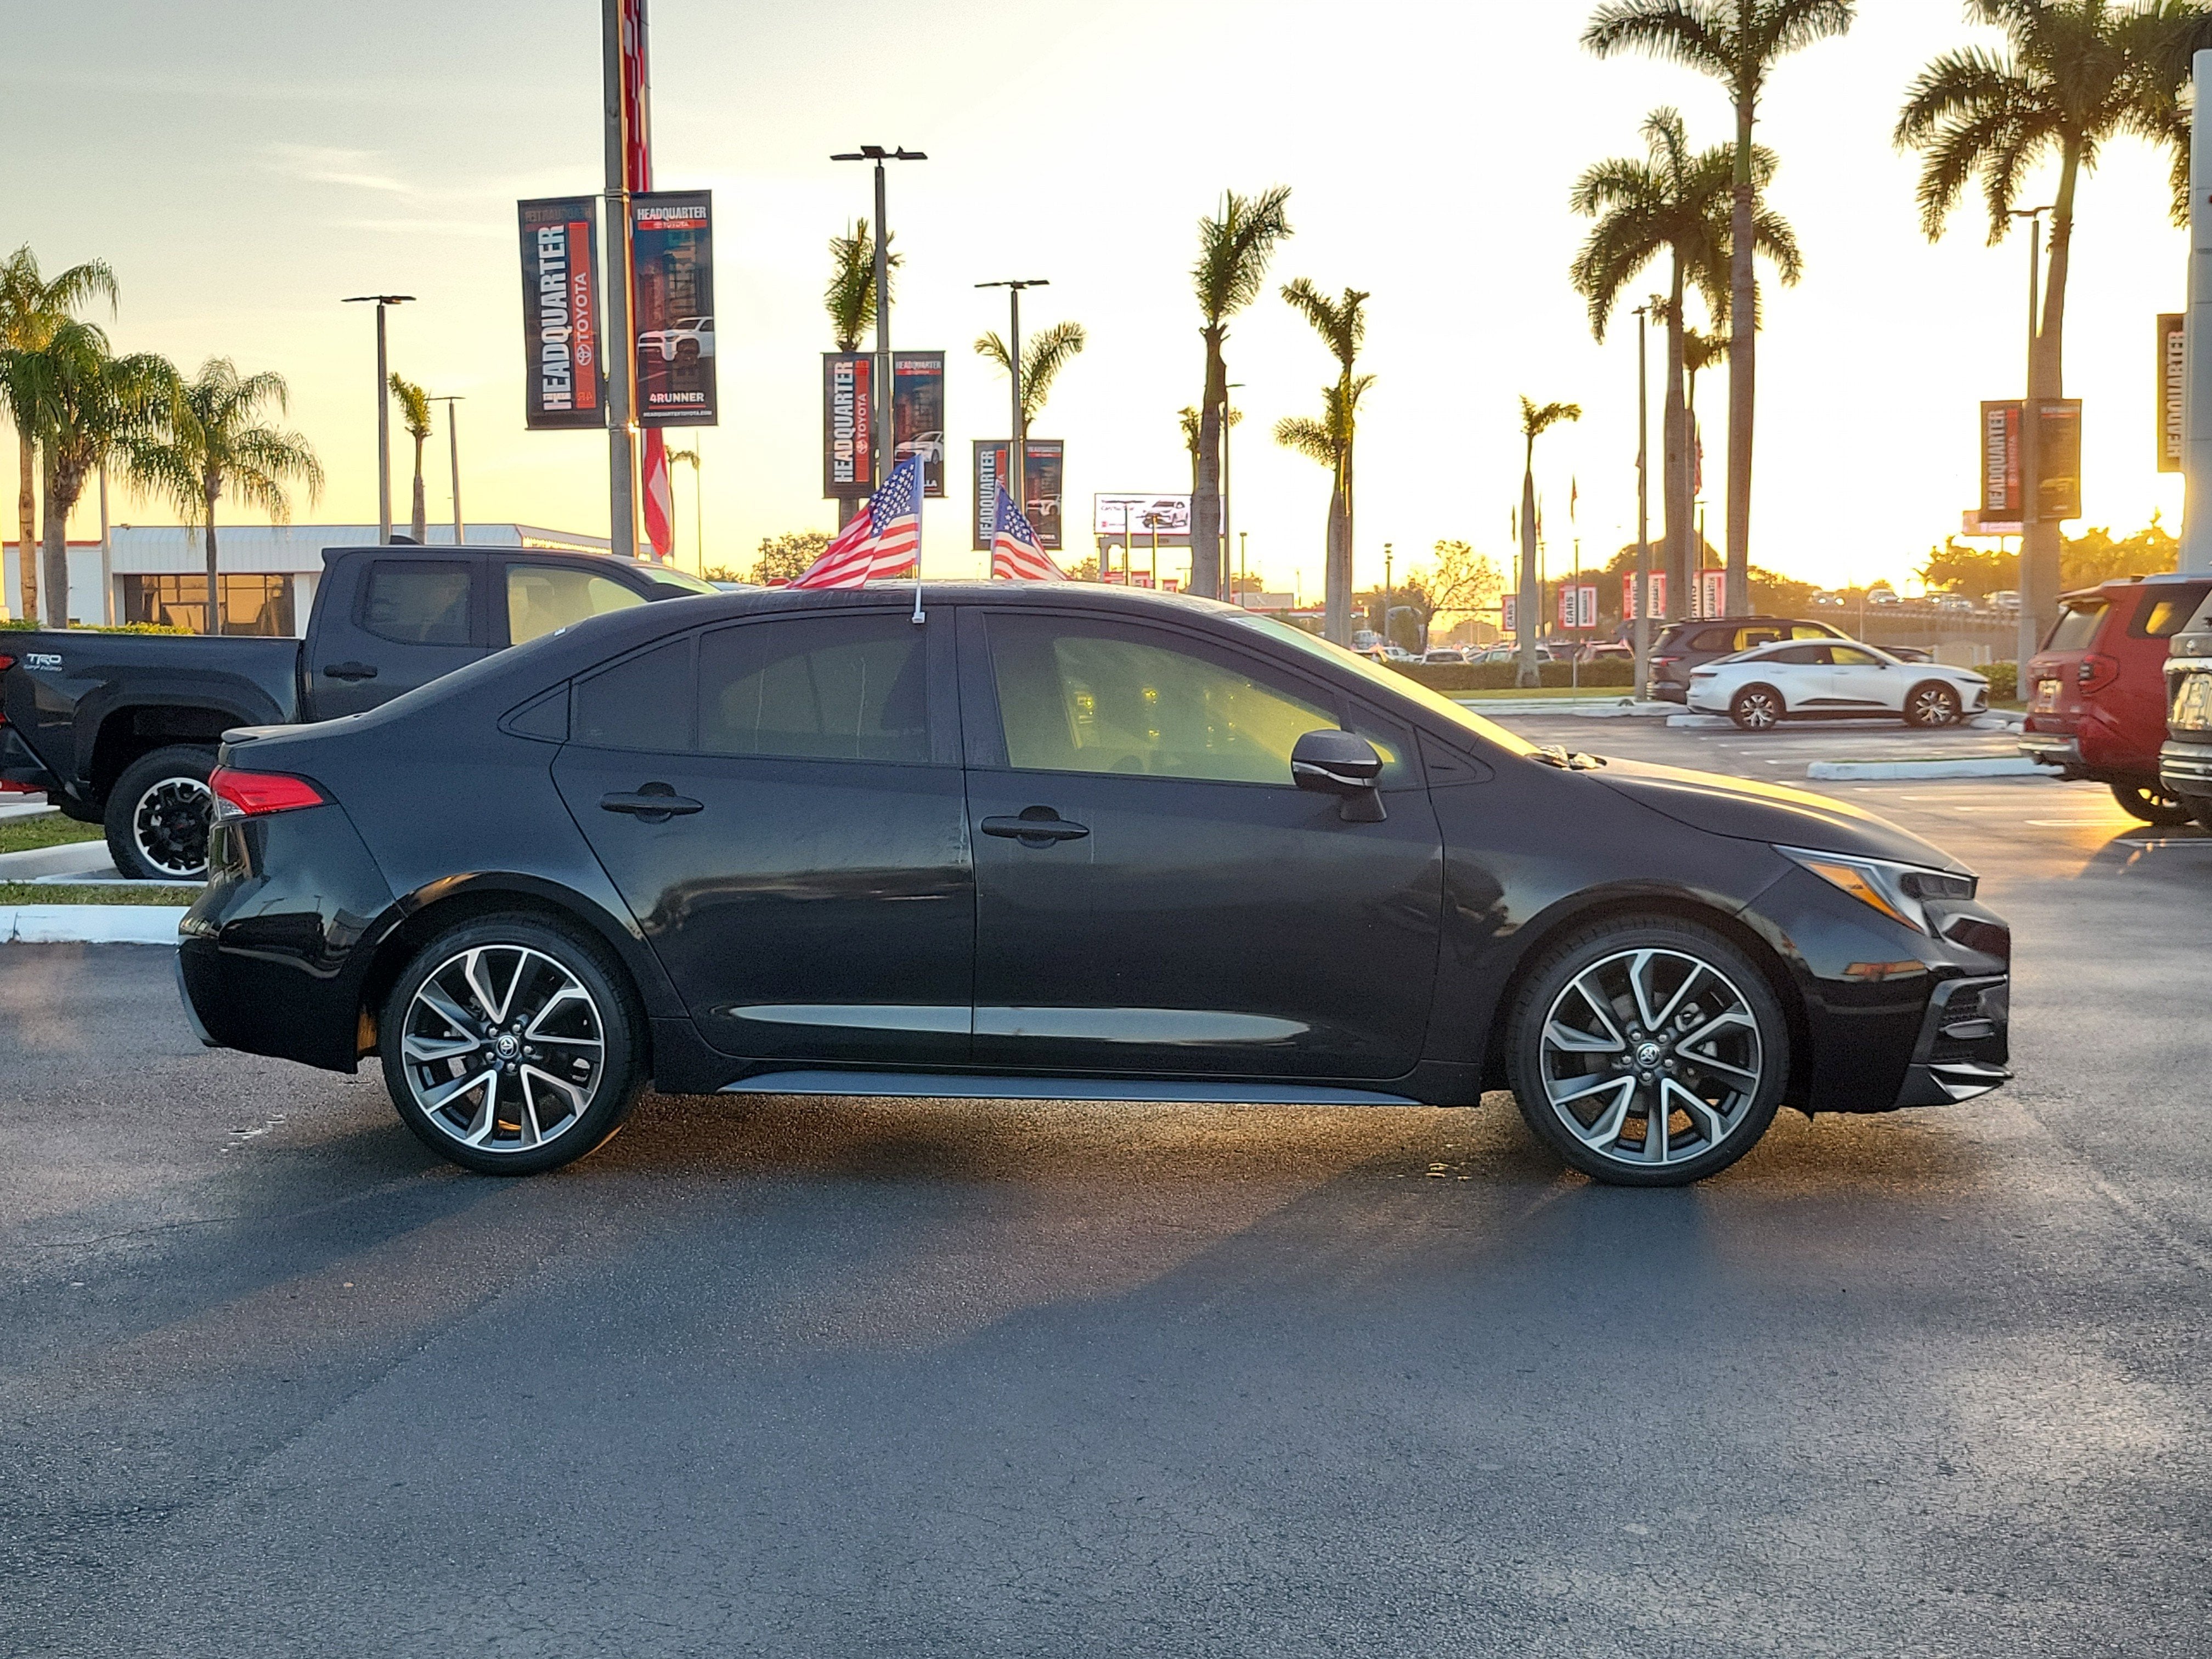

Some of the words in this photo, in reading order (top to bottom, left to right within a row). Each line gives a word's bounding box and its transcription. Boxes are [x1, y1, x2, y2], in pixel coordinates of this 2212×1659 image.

[637, 206, 707, 221] HEADQUARTER
[538, 224, 573, 411] HEADQUARTER
[575, 272, 589, 342] TOYOTA
[649, 392, 705, 403] 4RUNNER
[833, 362, 855, 483] HEADQUARTER
[857, 393, 867, 438] TOYOTA
[979, 450, 996, 540] HEADQUARTER
[1566, 596, 1574, 623] CARS
